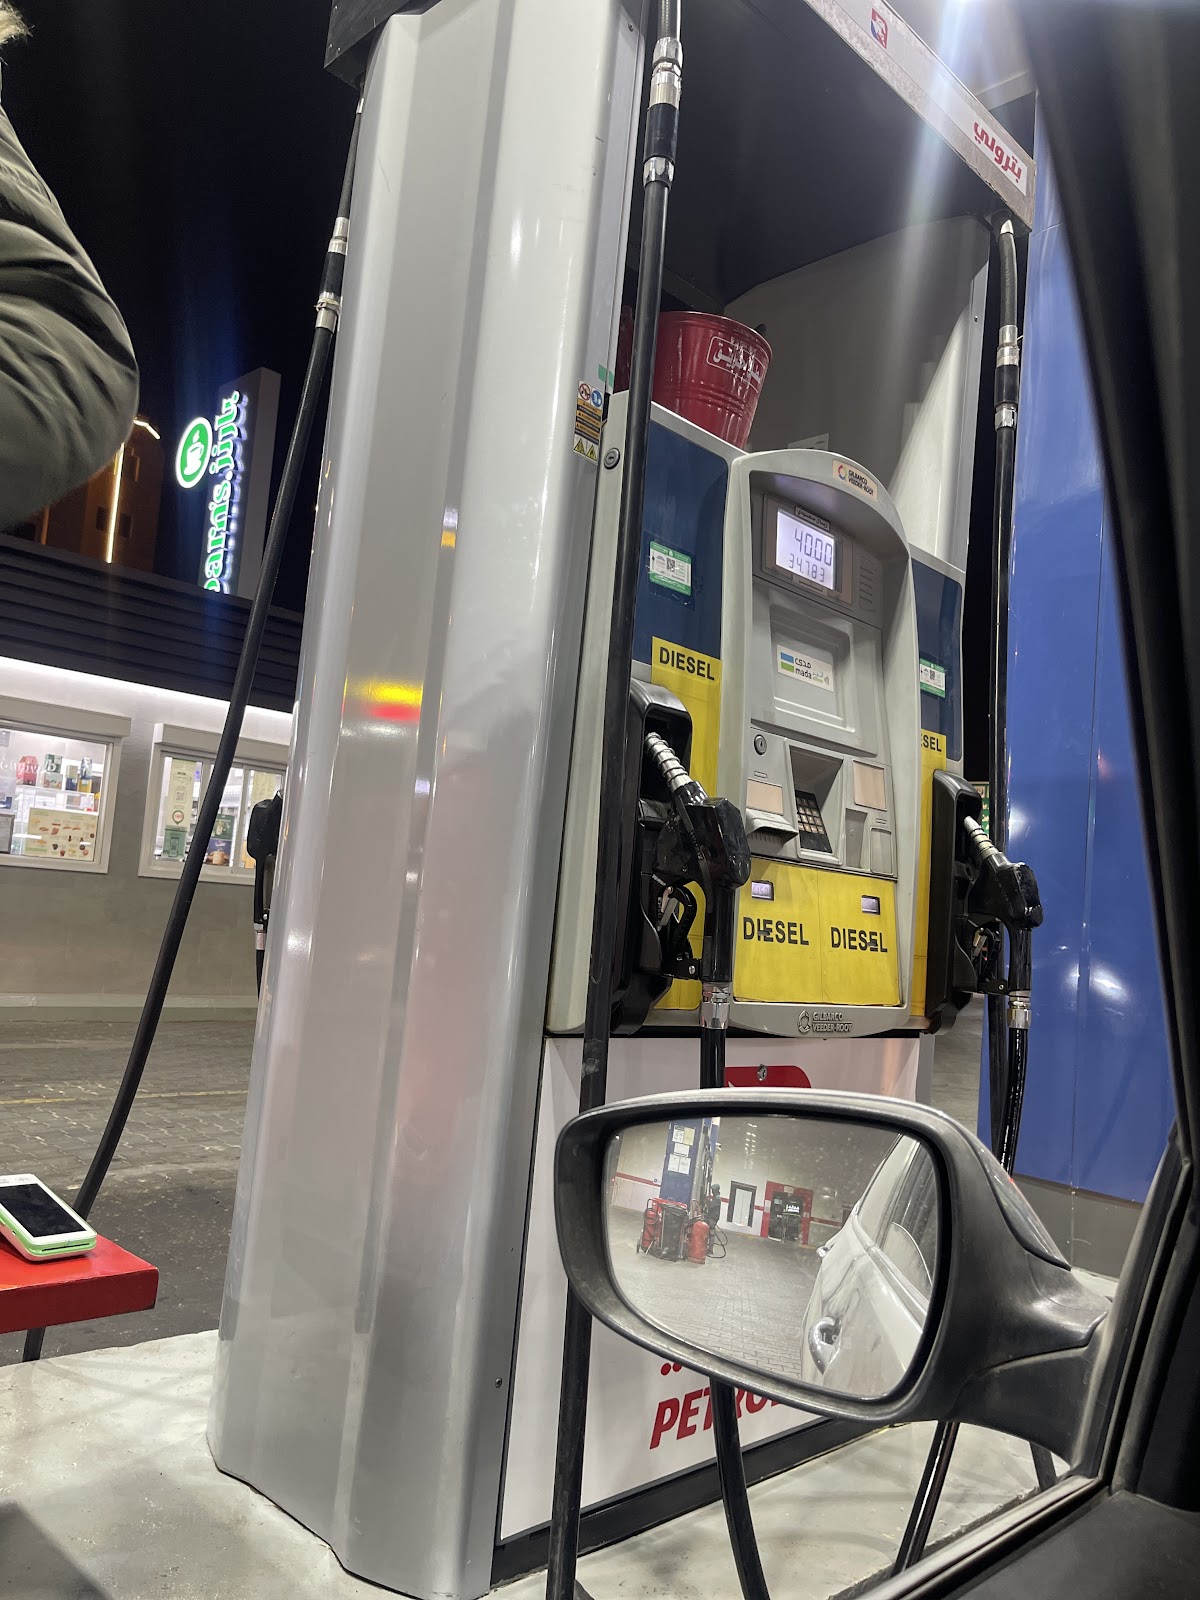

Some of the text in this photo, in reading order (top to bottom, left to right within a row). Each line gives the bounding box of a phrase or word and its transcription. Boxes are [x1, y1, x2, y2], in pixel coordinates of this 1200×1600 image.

[973, 121, 1022, 184] بترولي
[659, 646, 715, 681] DIESEL
[796, 667, 812, 680] mada
[743, 916, 809, 946] DIESEL
[830, 926, 888, 953] DIESEL
[812, 1011, 844, 1021] GILBARCO
